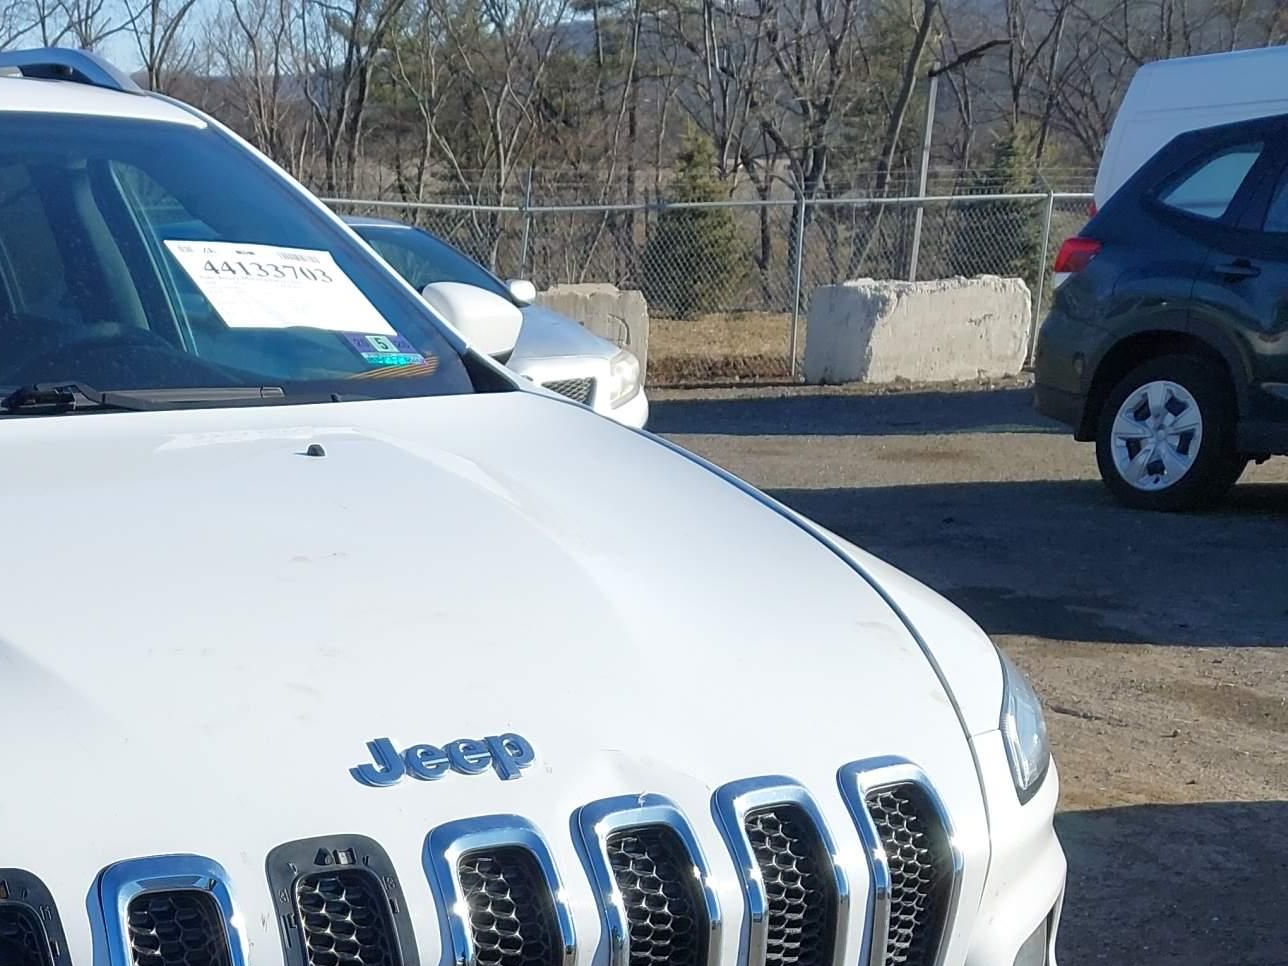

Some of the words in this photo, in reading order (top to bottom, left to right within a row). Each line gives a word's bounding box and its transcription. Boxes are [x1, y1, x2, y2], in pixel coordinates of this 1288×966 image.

[204, 259, 333, 283] 44133703
[374, 337, 389, 350] 5
[349, 732, 535, 787] Jeep
